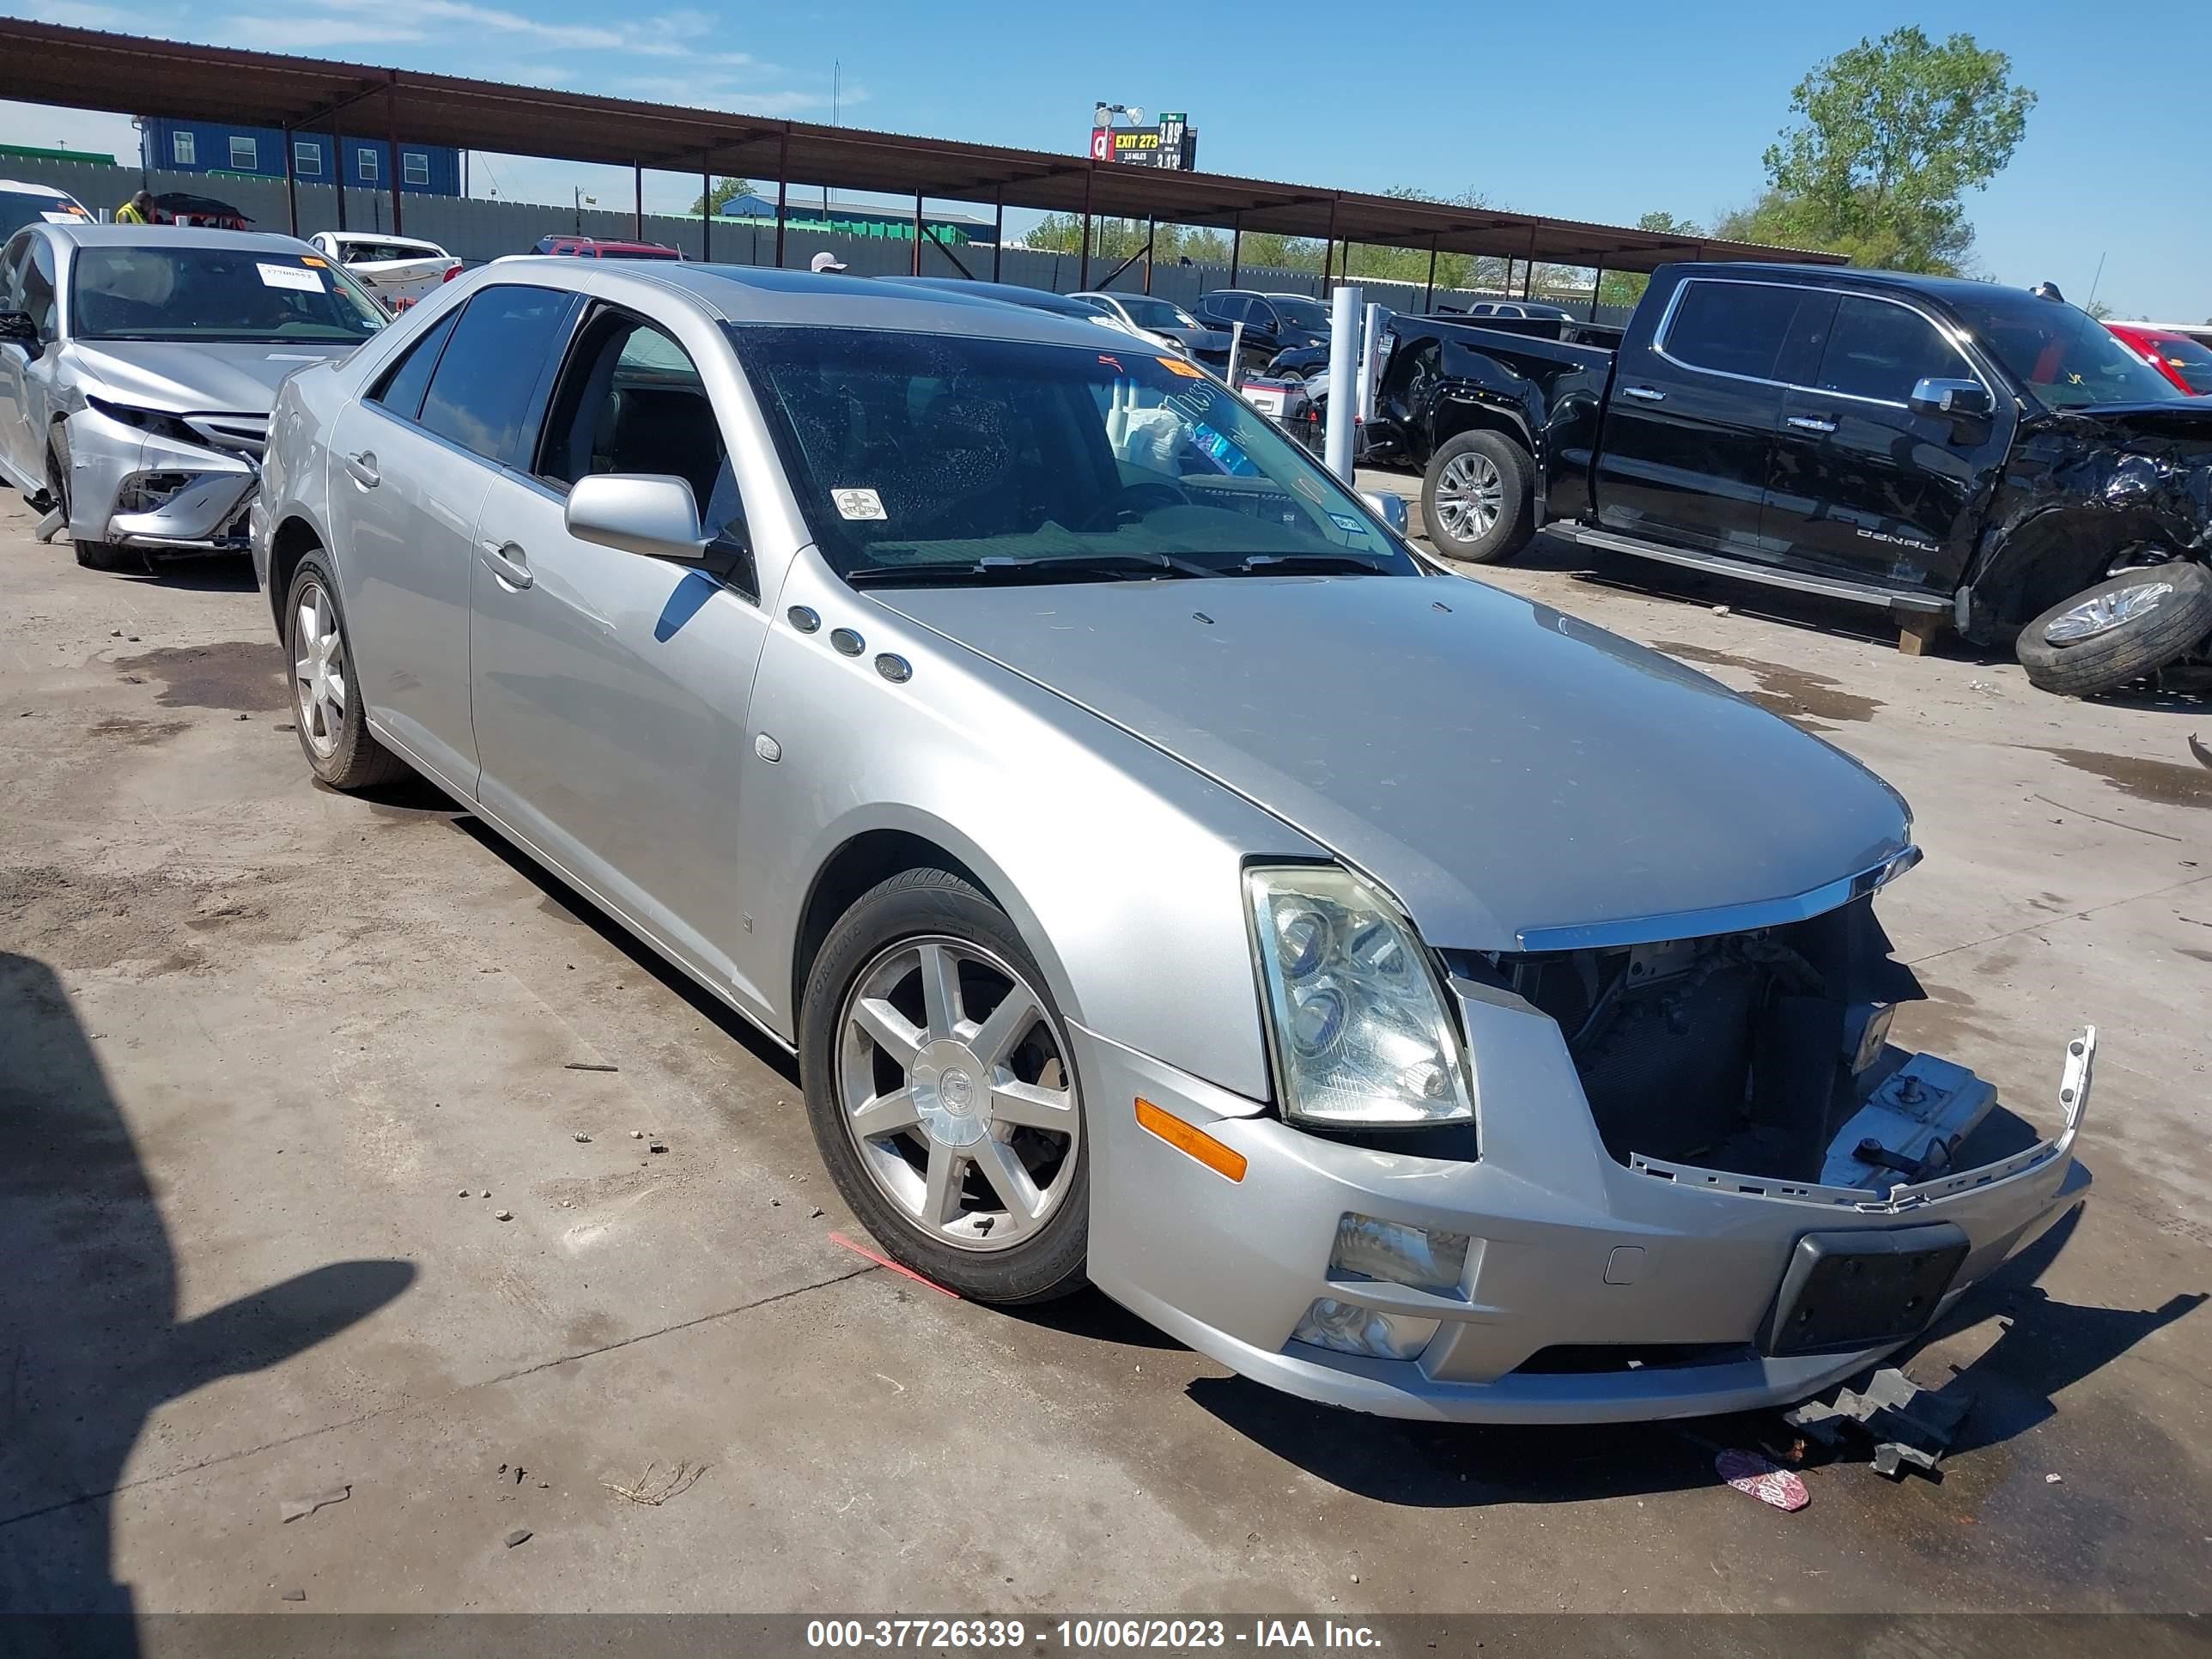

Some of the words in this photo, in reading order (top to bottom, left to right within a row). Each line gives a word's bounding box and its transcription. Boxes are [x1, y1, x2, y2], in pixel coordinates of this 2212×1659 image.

[1115, 135, 1138, 149] EXIT
[1139, 134, 1158, 149] 273
[1856, 528, 1940, 552] DENALI
[810, 921, 861, 1011] FORTUNE
